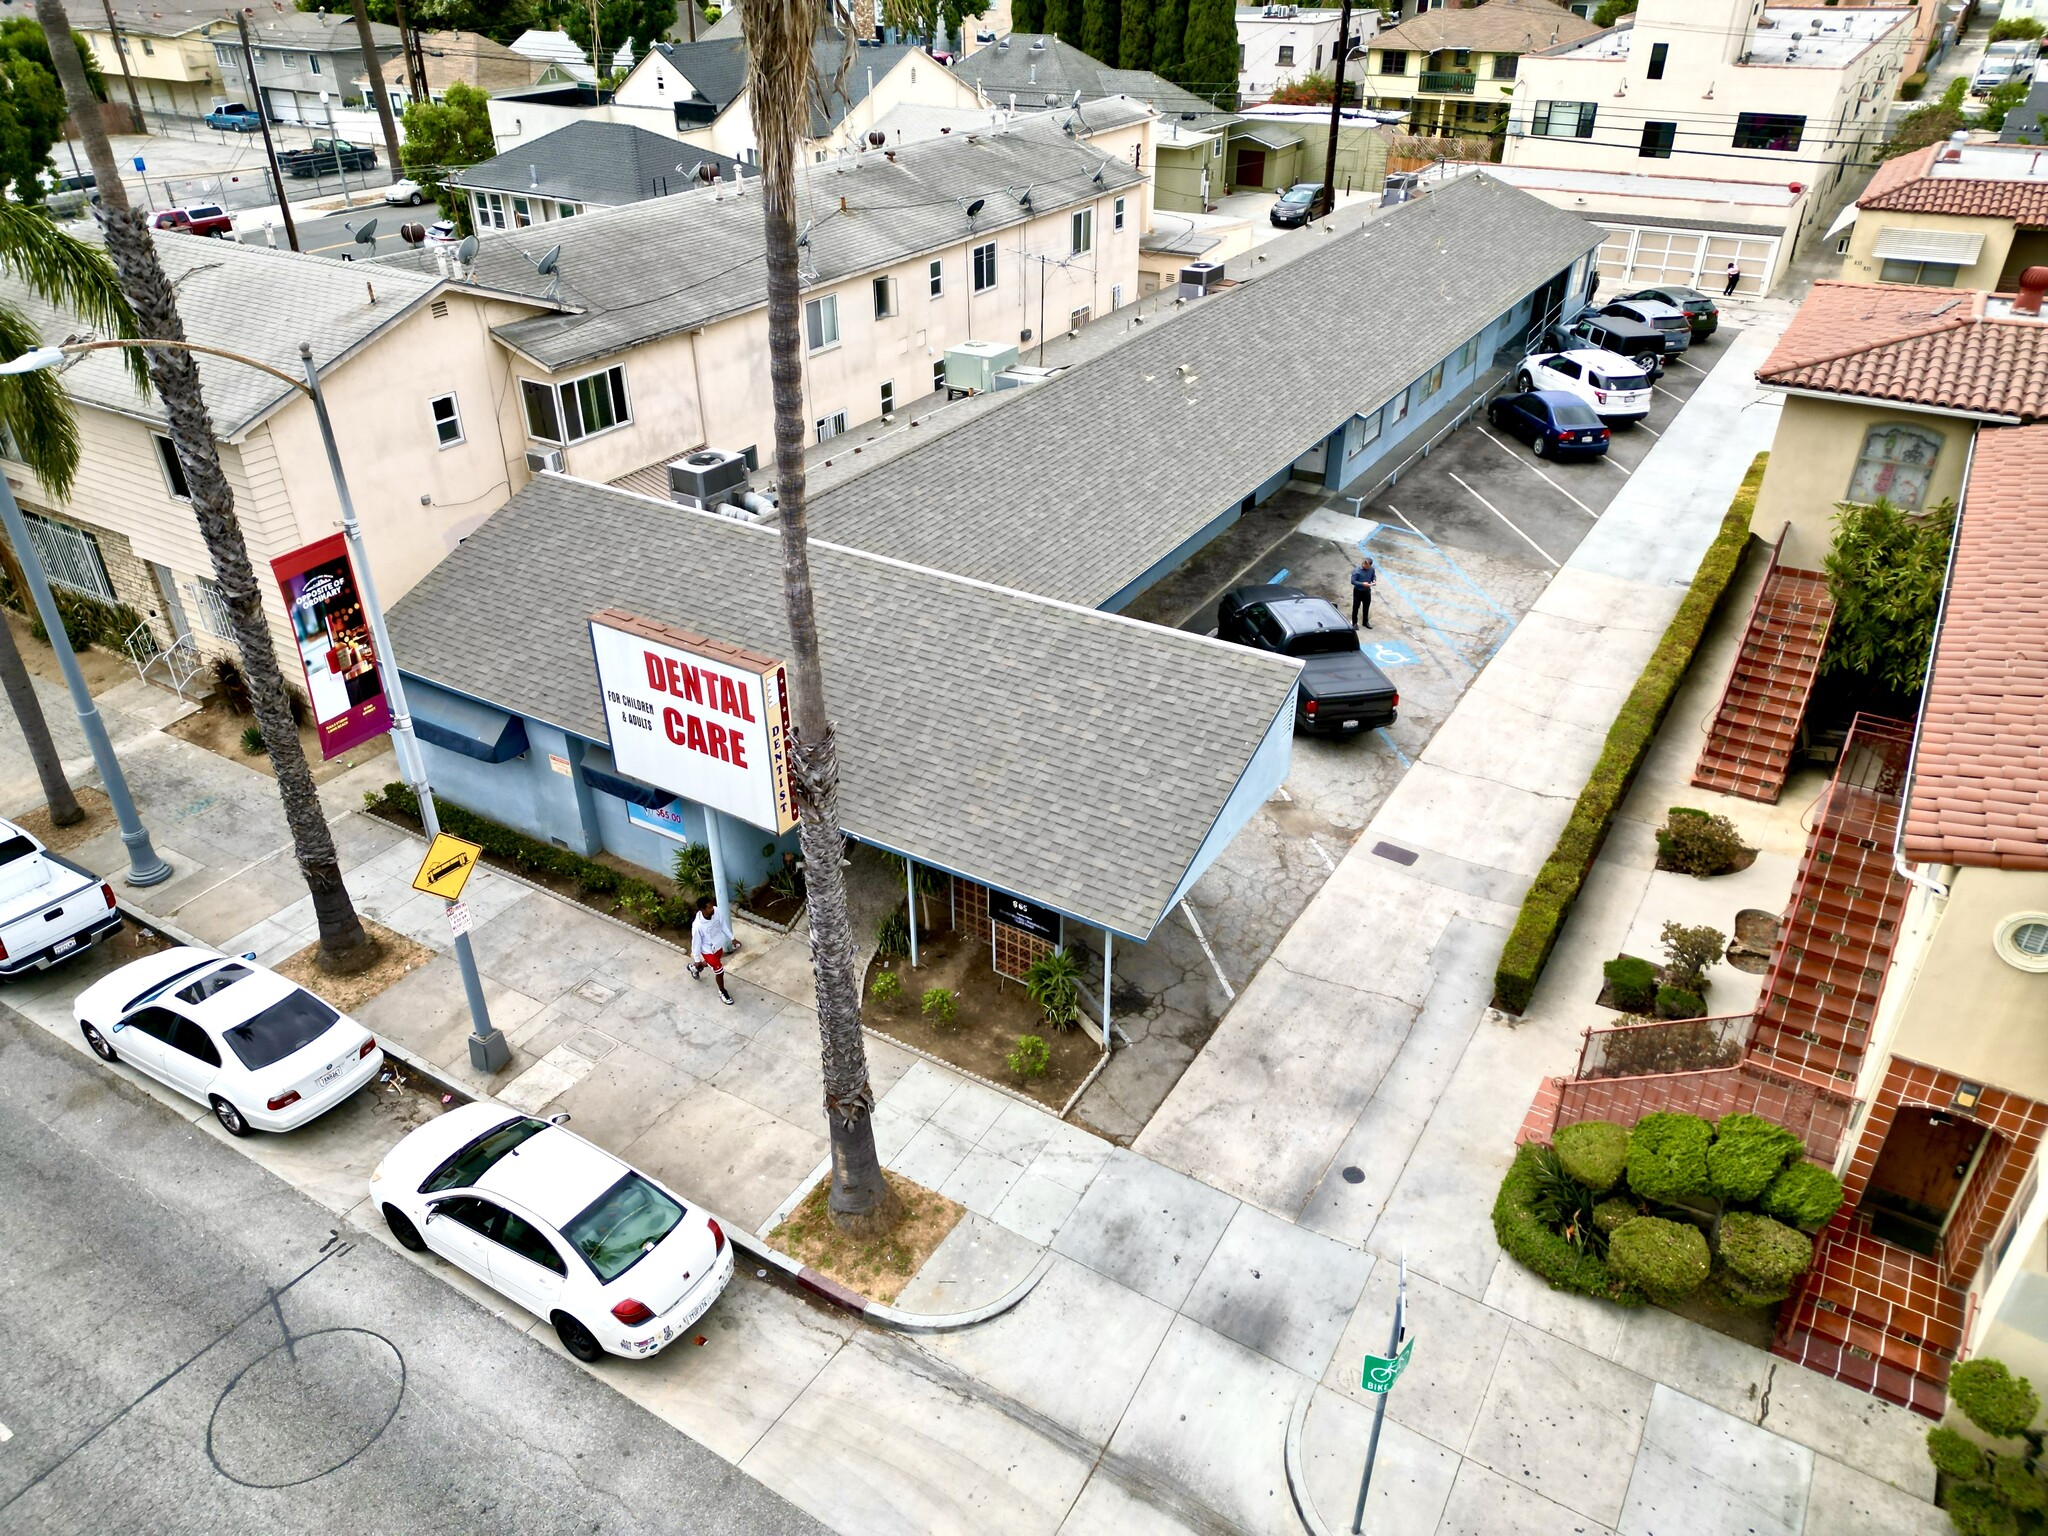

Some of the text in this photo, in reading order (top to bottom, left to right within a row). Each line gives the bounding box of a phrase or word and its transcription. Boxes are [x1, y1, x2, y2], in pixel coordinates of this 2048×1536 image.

[296, 582, 334, 606] OPPOSITE
[333, 577, 345, 587] OF
[302, 586, 342, 610] ORDINARY
[643, 651, 756, 724] DENTAL
[607, 690, 655, 716] FOR CHILDREN
[621, 712, 654, 731] & ADULTS
[662, 706, 749, 770] CARE
[771, 725, 788, 814] DENTIST
[655, 808, 682, 824] $65.00
[1367, 1382, 1389, 1392] BIKE
